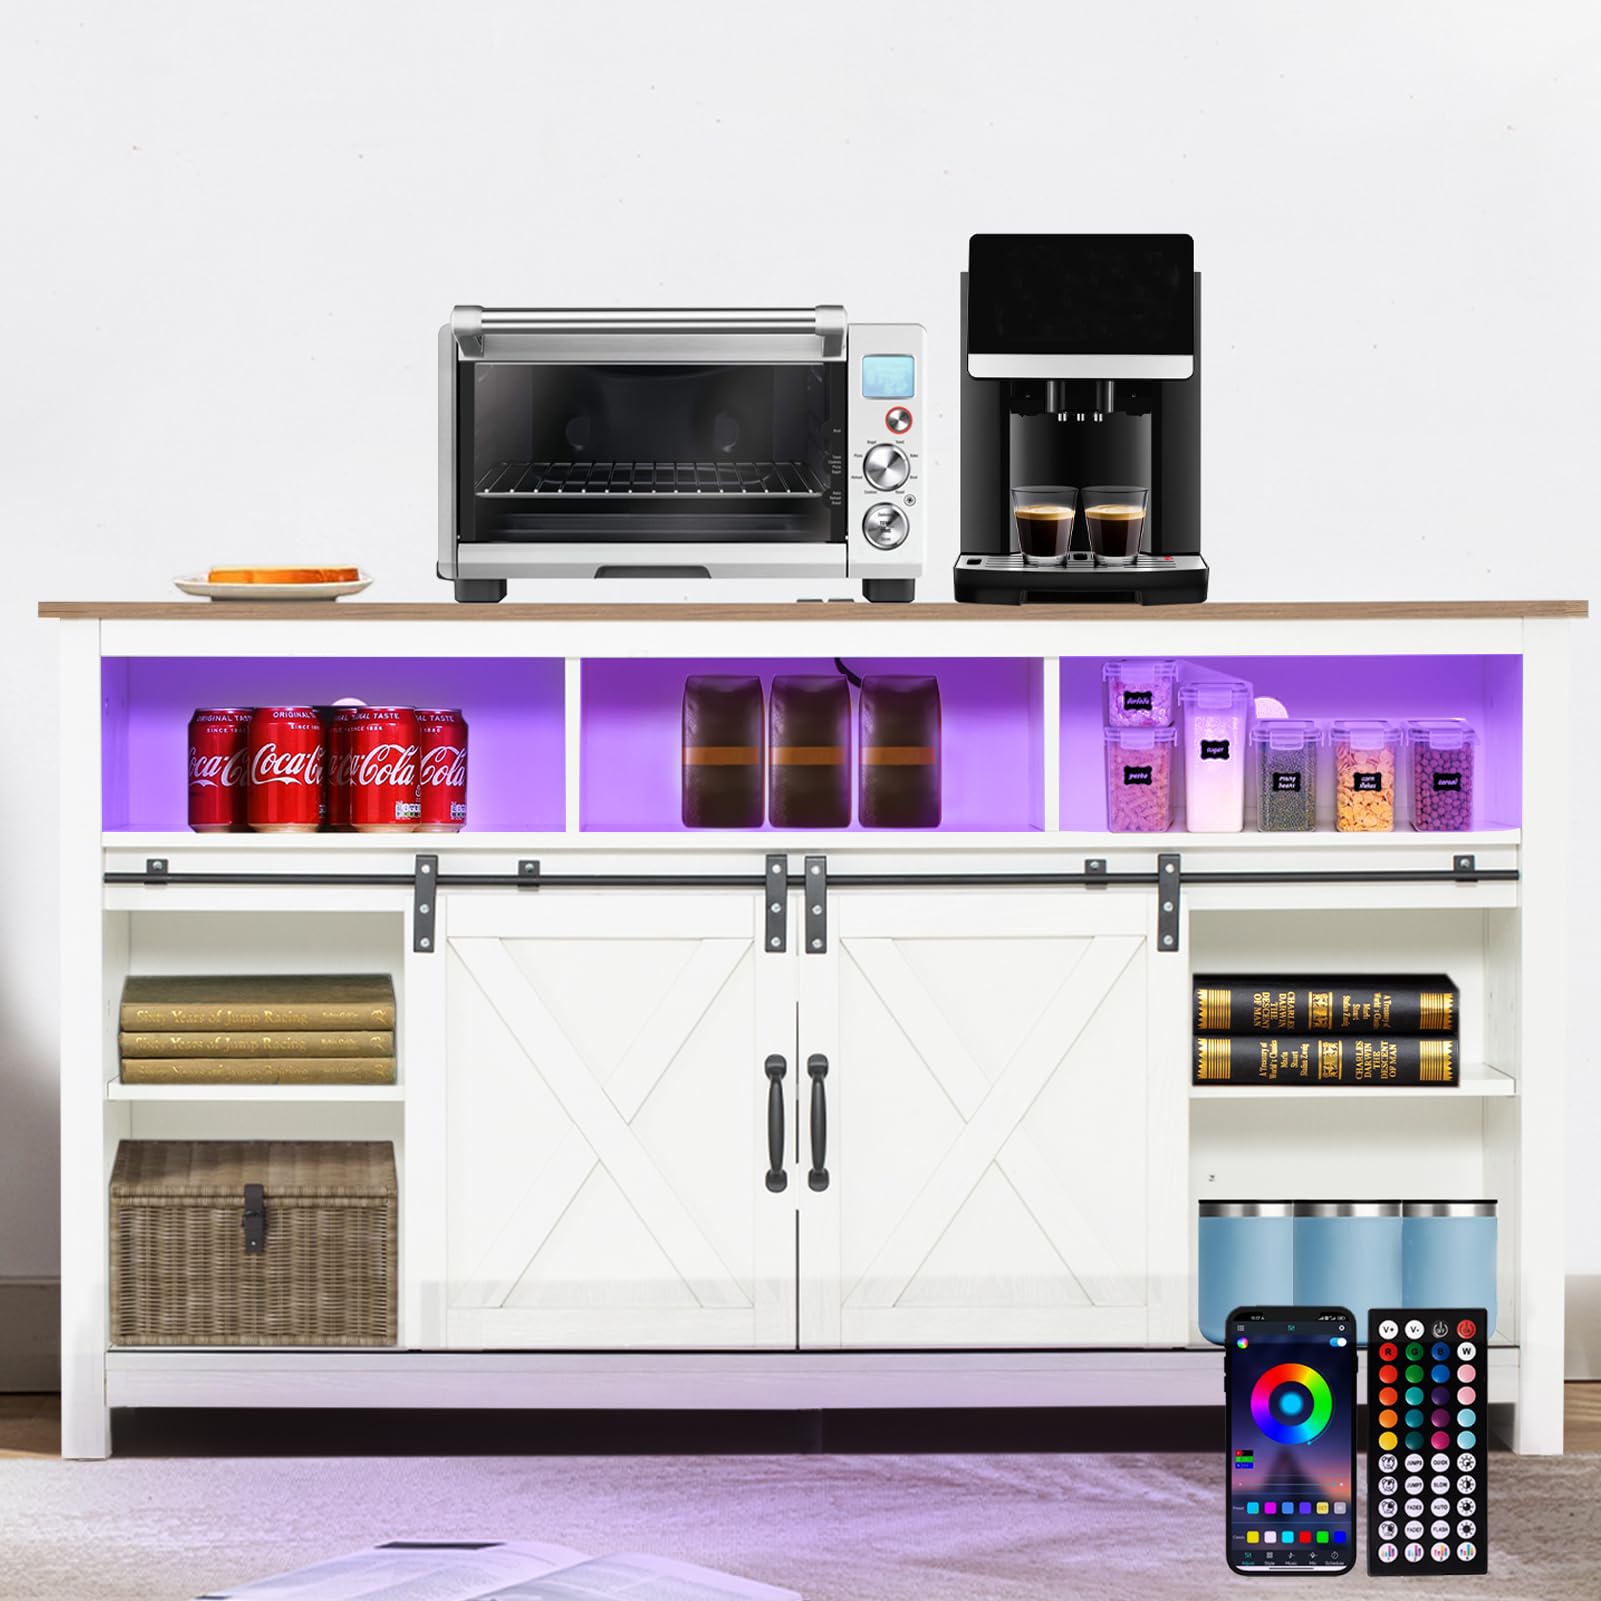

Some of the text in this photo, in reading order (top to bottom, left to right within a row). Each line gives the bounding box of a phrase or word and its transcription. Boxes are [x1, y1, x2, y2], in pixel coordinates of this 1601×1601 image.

[273, 710, 310, 718] ORIGINAL
[136, 1010, 309, 1026] Sixty Years of Jump Racing
[1254, 993, 1262, 1027] OF MAN
[1262, 992, 1270, 1028] DESCENT
[1279, 993, 1287, 1028] DARWIN
[1287, 991, 1296, 1030] CHARLES
[1355, 1040, 1363, 1080] CHARLES
[1389, 1044, 1397, 1078] OF MAN
[1384, 1348, 1392, 1356] R
